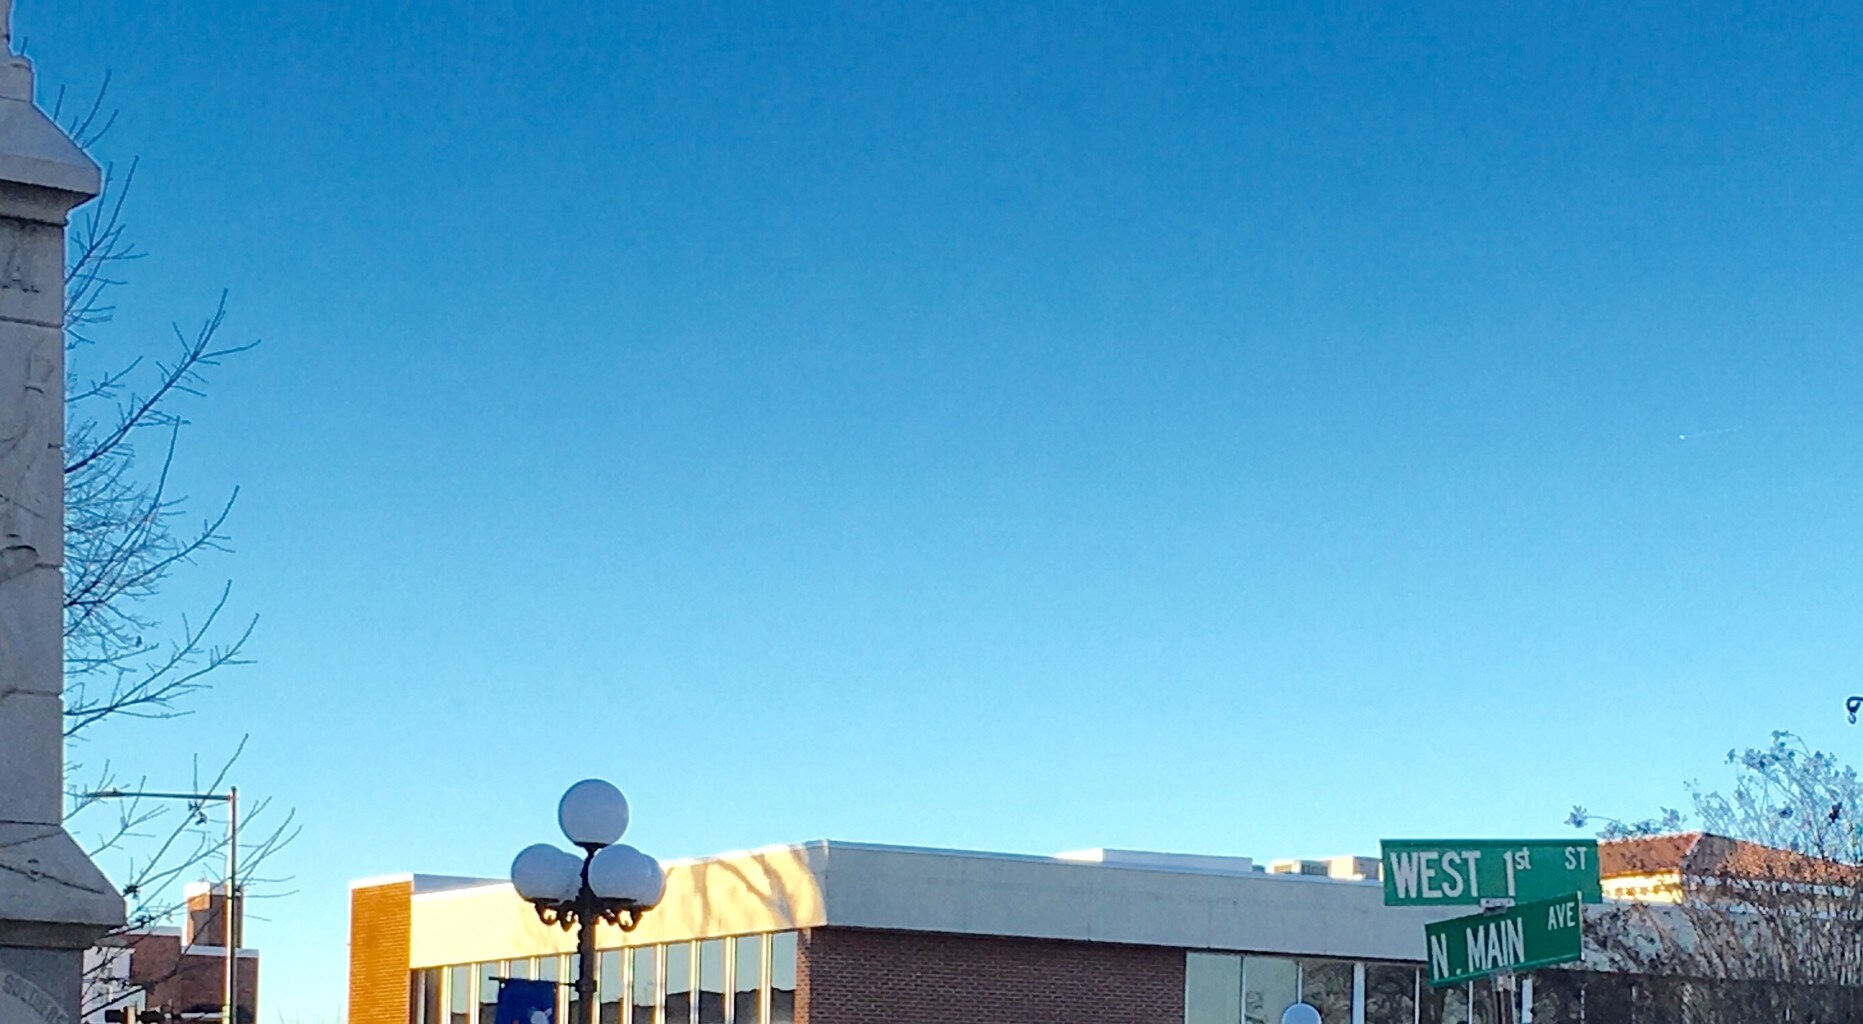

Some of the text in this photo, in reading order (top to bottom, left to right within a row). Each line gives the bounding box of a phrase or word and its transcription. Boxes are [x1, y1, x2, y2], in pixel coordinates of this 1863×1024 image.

[1389, 846, 1588, 899] WEST 1st ST
[1466, 917, 1525, 973] MAIN
[1547, 901, 1576, 931] AVE
